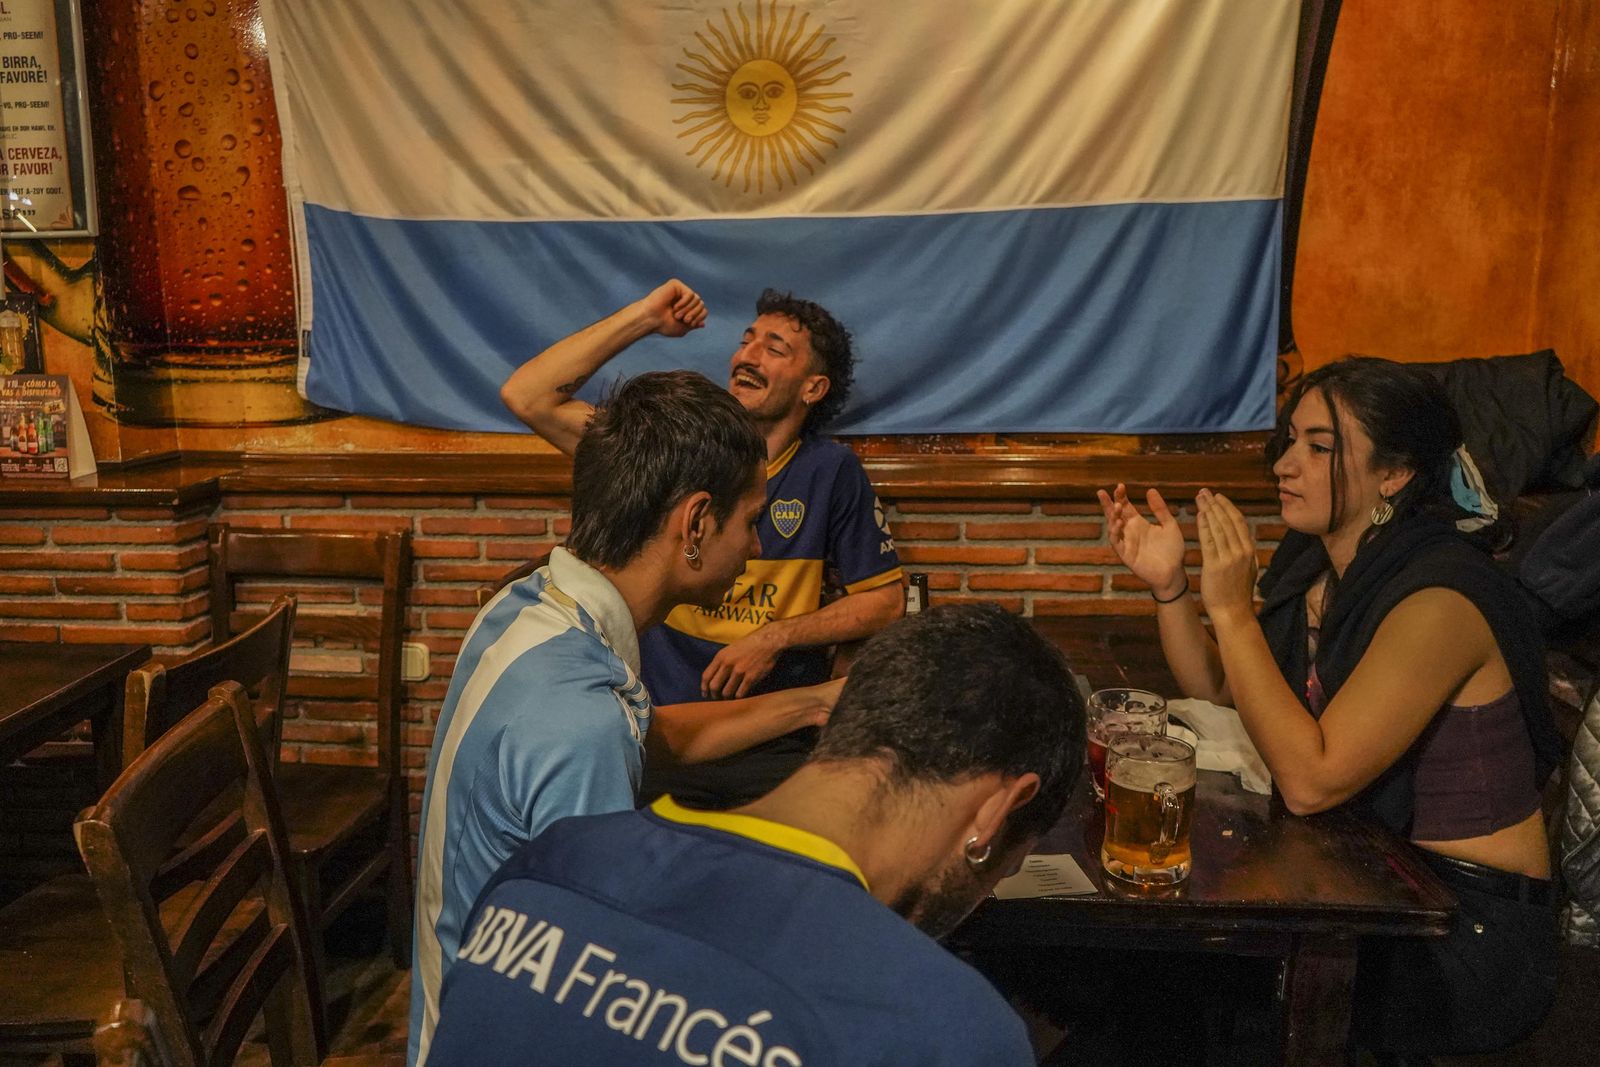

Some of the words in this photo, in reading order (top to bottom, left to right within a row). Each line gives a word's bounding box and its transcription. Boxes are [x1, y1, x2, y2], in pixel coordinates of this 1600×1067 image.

[2, 55, 42, 69] BIRRA,
[0, 70, 48, 84] FAVORE!
[8, 147, 62, 161] CERVEZA,
[13, 162, 53, 175] FAVOR!
[774, 510, 801, 520] CABJ
